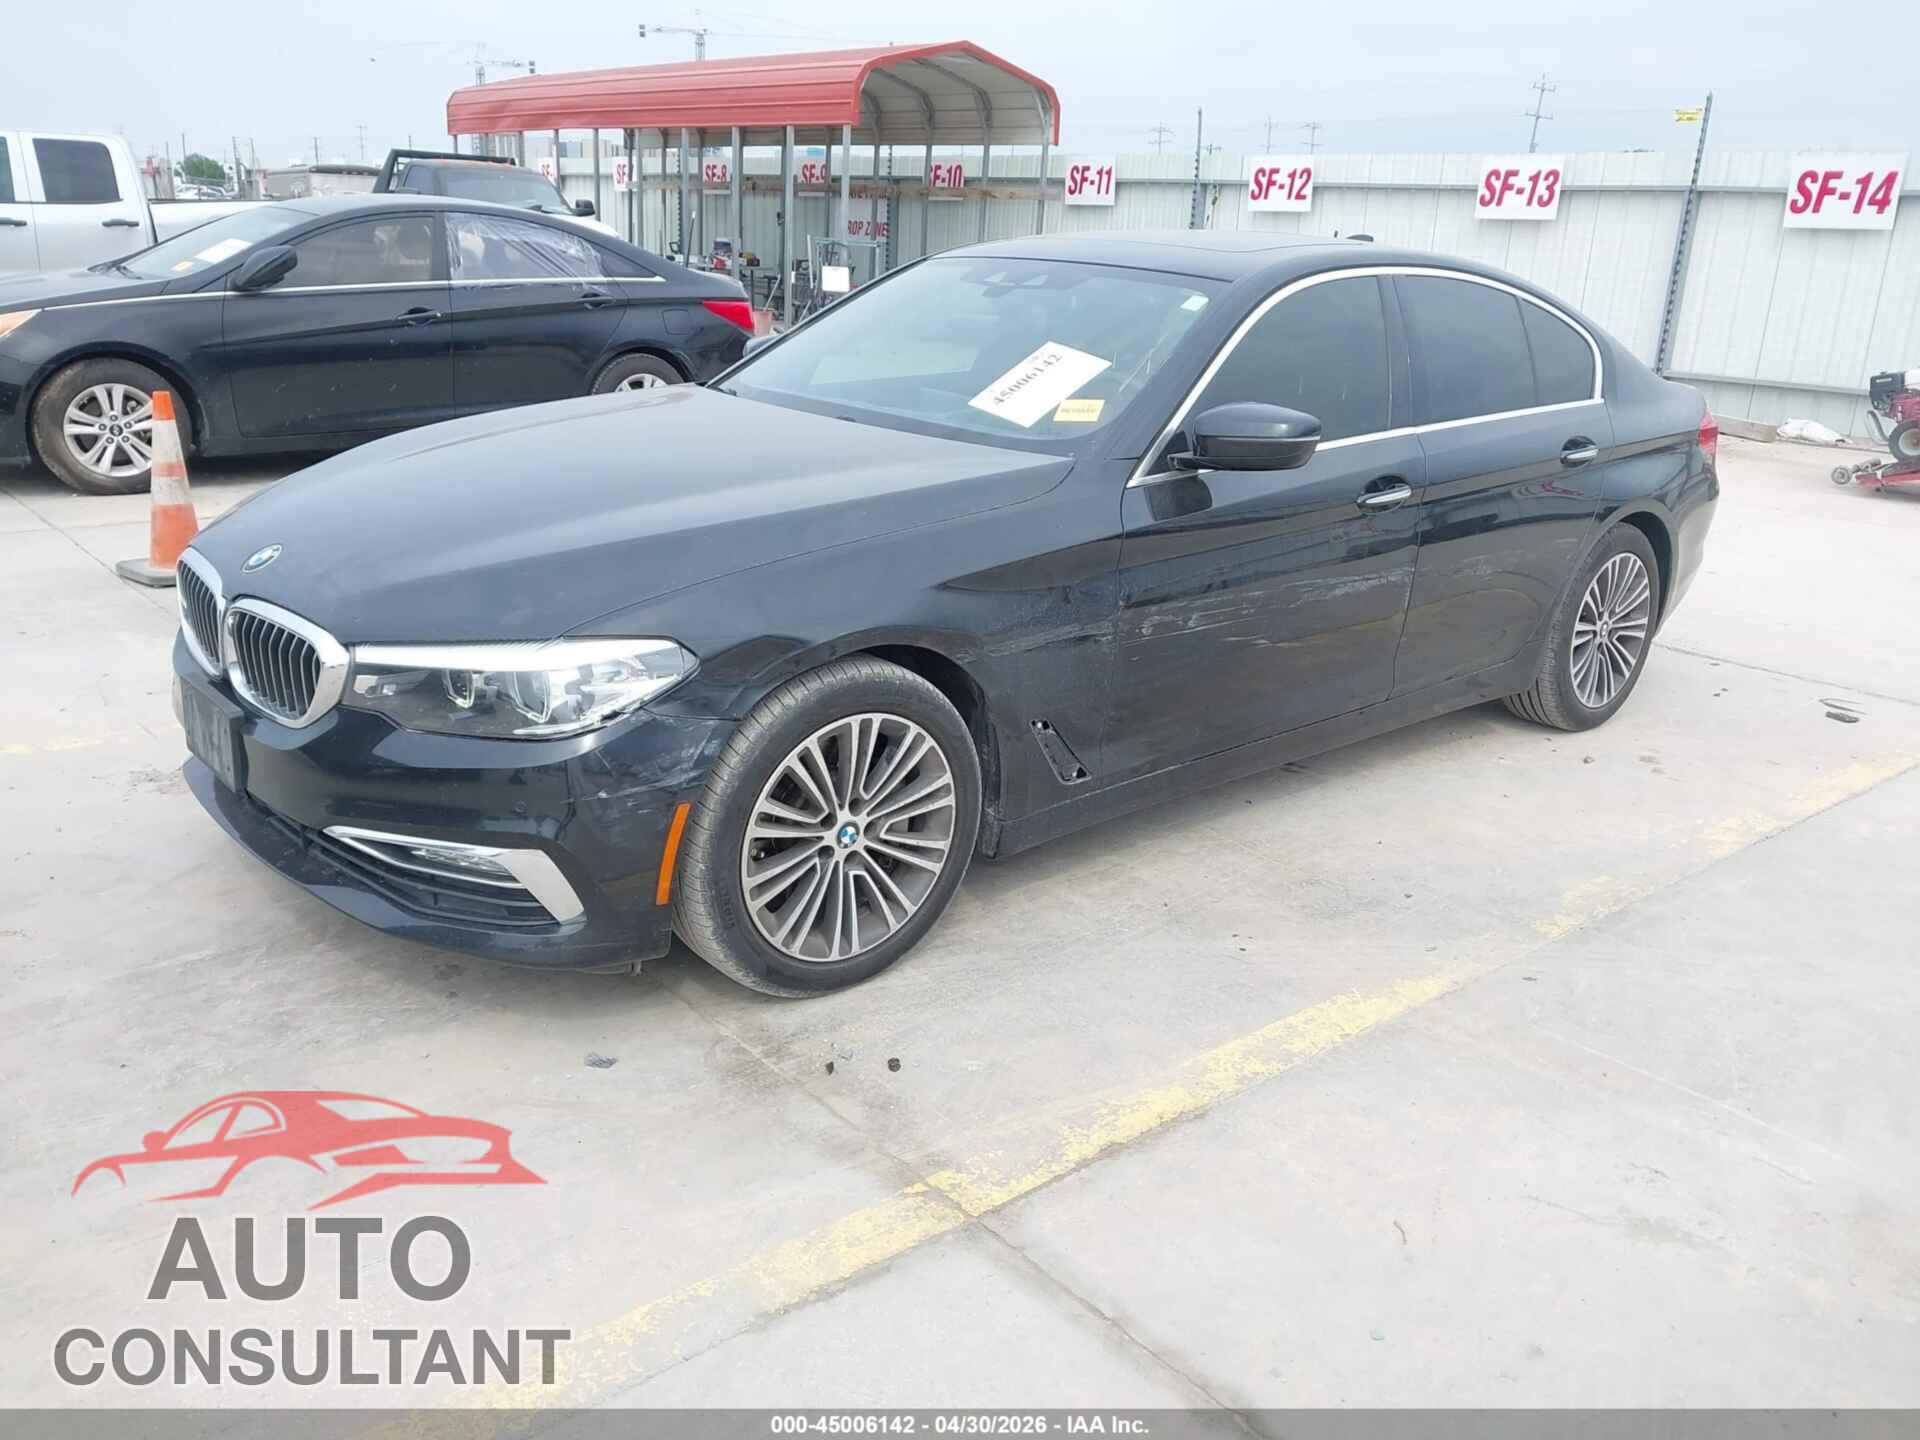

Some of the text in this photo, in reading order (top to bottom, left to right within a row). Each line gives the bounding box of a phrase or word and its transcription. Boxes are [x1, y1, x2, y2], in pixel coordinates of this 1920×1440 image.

[1067, 165, 1113, 196] SF-11
[1250, 167, 1313, 201] SF-12
[1479, 168, 1561, 208] SF-13
[1789, 170, 1900, 215] SF-14
